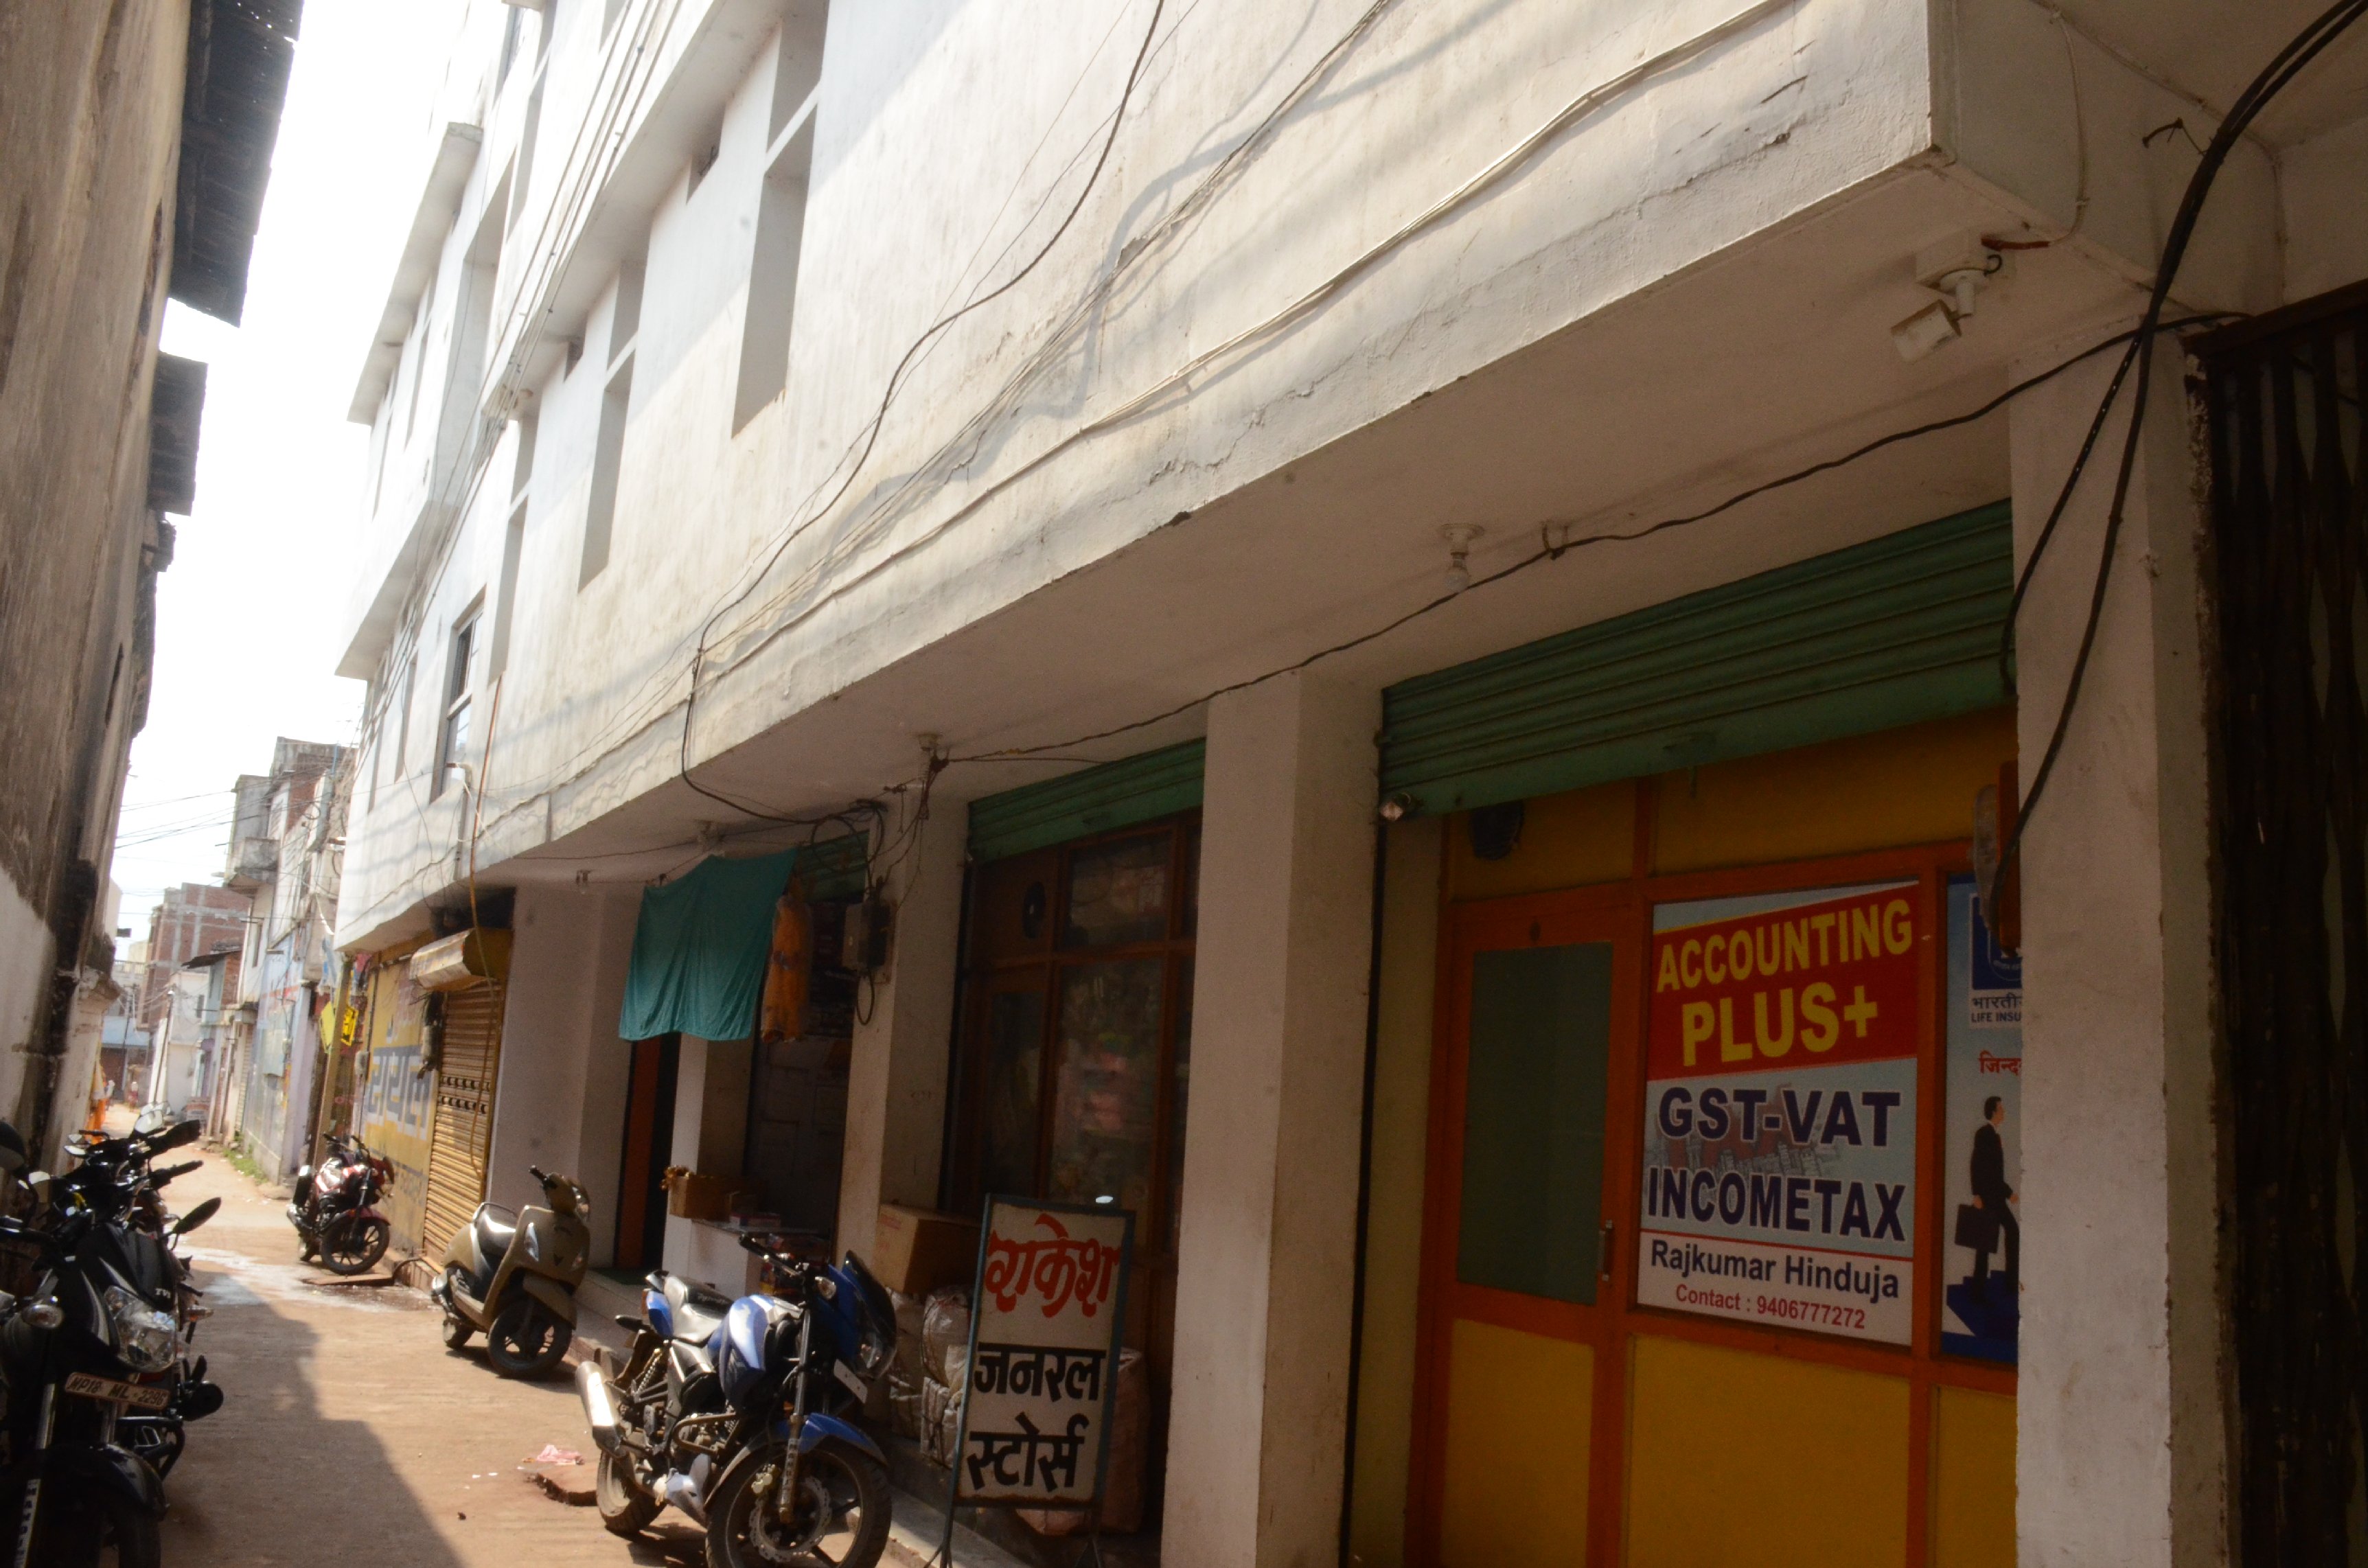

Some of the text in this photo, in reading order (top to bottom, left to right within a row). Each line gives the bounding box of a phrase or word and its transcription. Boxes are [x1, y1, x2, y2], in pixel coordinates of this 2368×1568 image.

[1656, 899, 1913, 992] ACCOUNTING
[1681, 982, 1878, 1066] PLUS+
[1971, 1012, 1992, 1023] LIFE
[1973, 992, 2022, 1010] भारती
[1978, 1050, 2022, 1076] जिन्द
[1658, 1086, 1900, 1146] GST-VAT
[984, 1214, 1122, 1318] राकेश
[1651, 1240, 1899, 1304] Rajkumar Hinduja
[1676, 1284, 1740, 1311] Contact
[1756, 1297, 1865, 1330] 9406777272
[108, 1383, 129, 1399] ML
[972, 1342, 1107, 1403] जनरल
[966, 1411, 1089, 1492] स्टोर्स
